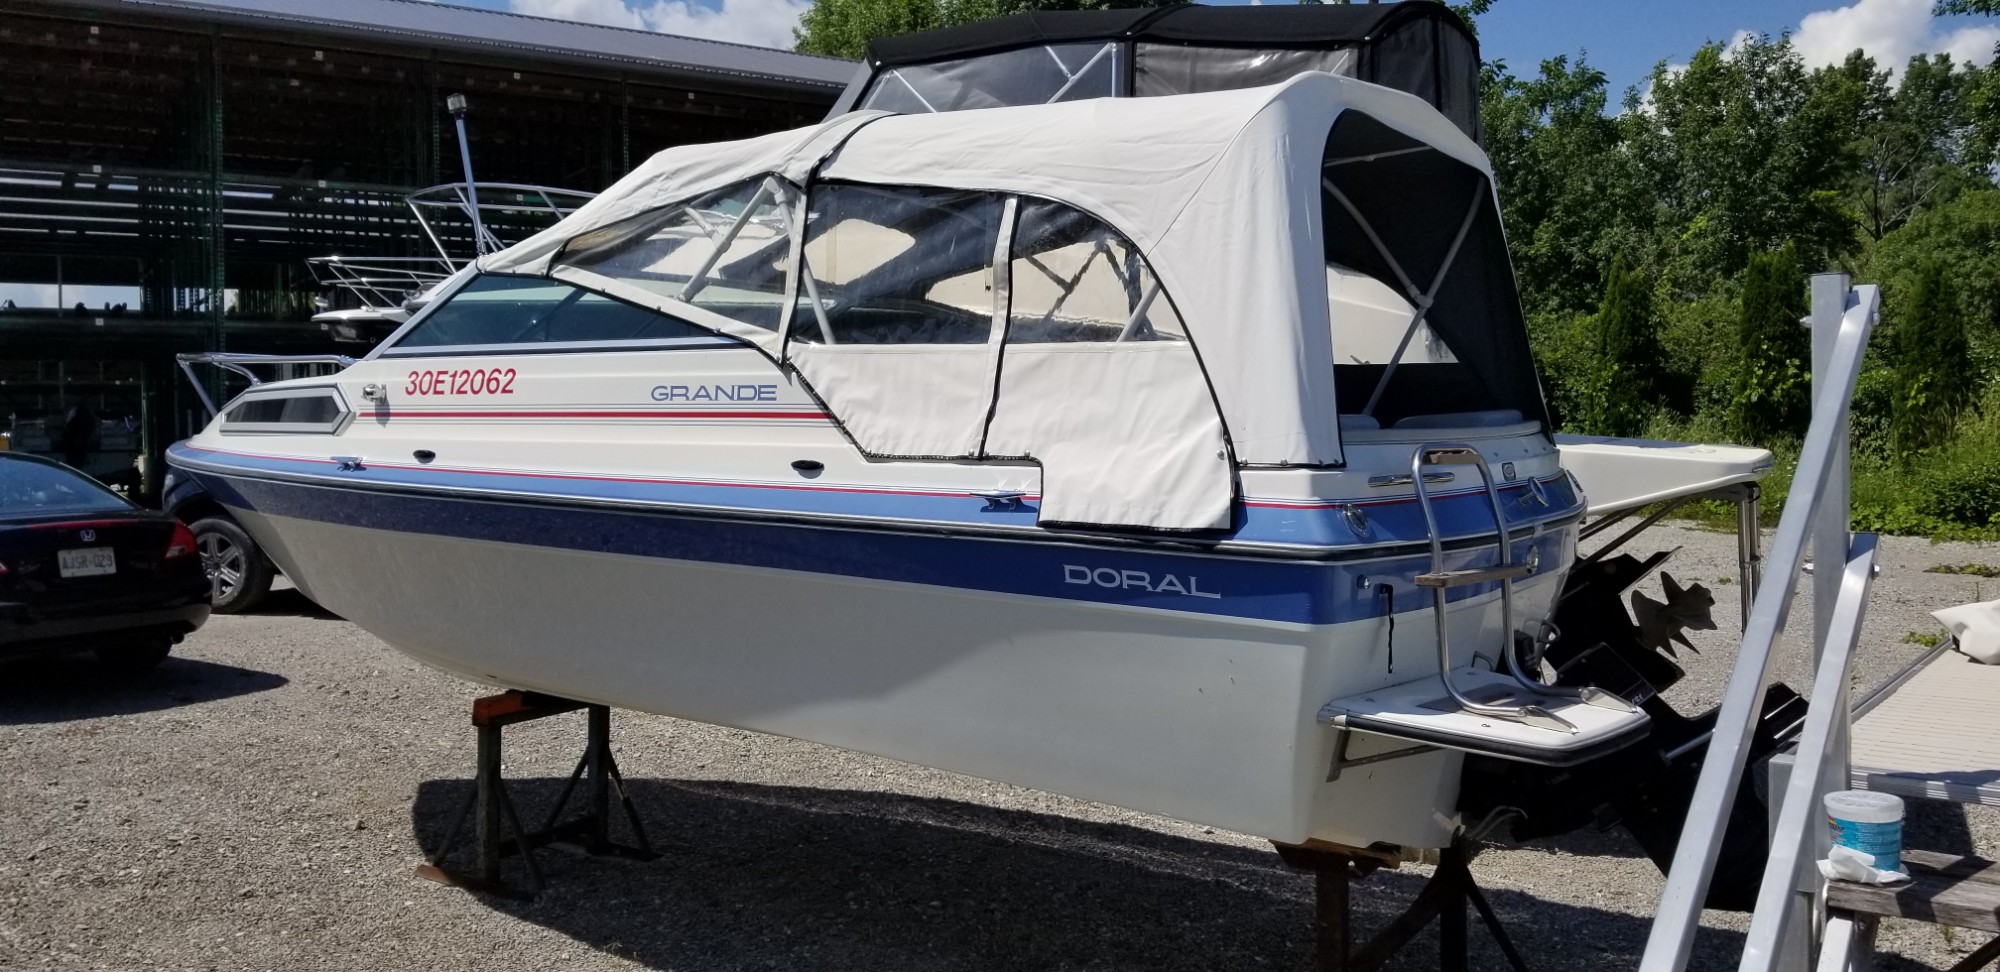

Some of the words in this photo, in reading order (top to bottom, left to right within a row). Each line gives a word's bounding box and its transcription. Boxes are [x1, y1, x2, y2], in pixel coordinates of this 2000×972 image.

[405, 368, 516, 396] 30E12062
[651, 385, 777, 401] GRANDE
[1063, 564, 1221, 599] DORAL
